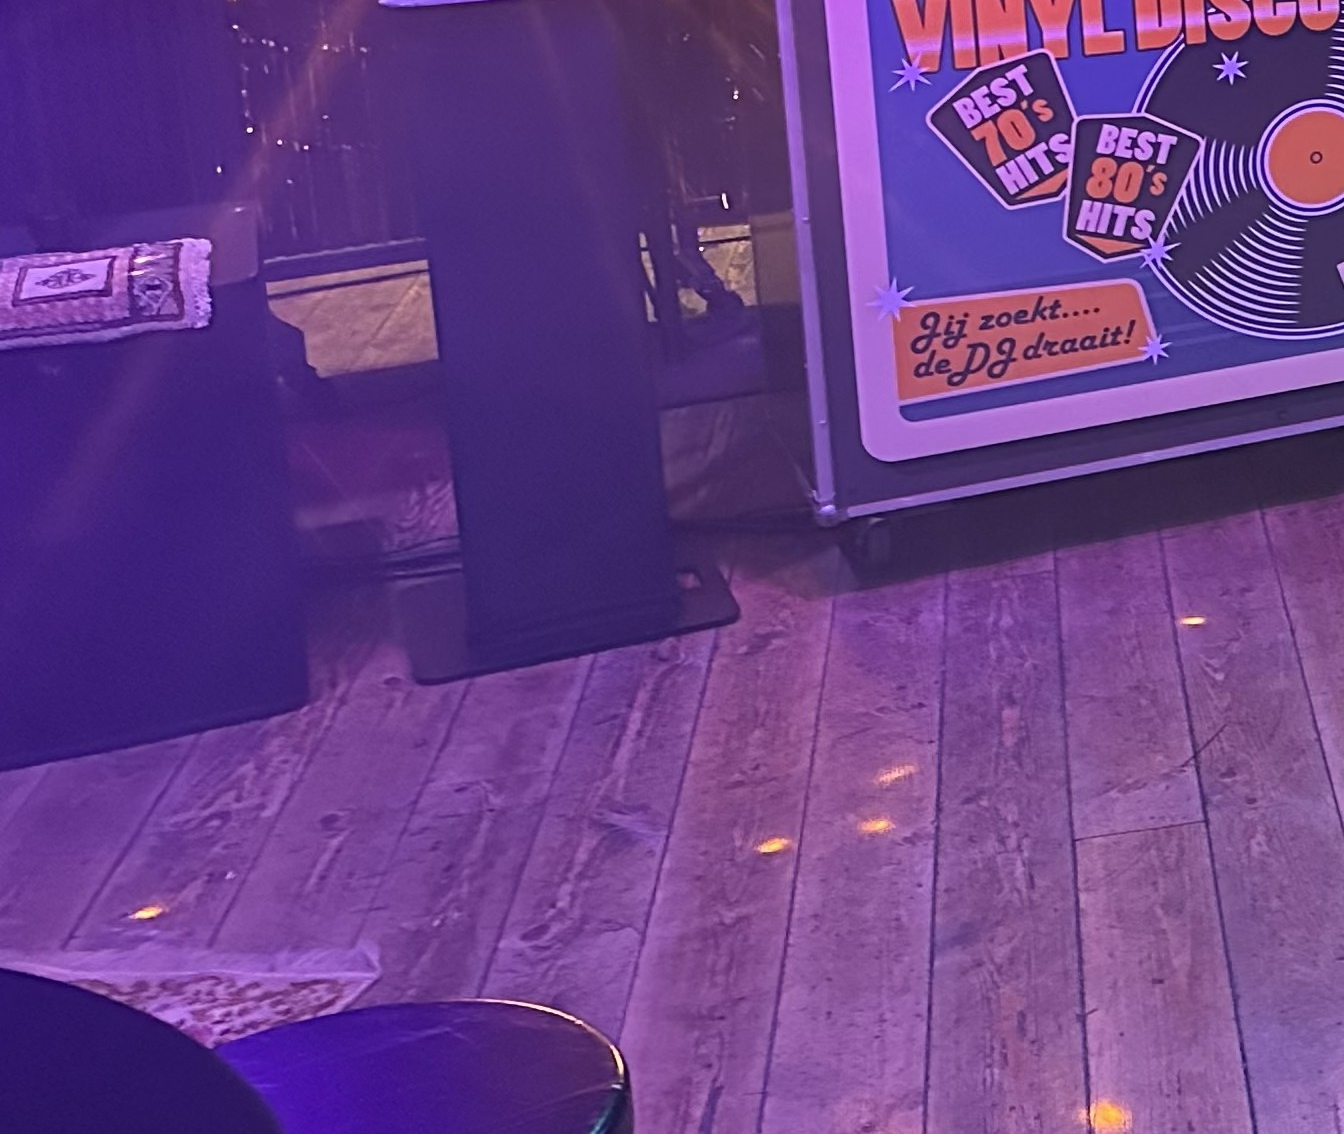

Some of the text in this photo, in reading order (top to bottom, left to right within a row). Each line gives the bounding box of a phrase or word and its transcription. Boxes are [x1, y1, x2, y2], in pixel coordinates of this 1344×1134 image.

[952, 64, 1034, 129] BEST
[970, 98, 1054, 166] 70's
[1095, 123, 1178, 164] BEST
[995, 133, 1071, 195] HITS
[1085, 156, 1168, 203] 80's
[1075, 199, 1155, 240] HITS
[910, 311, 970, 355] Jij
[913, 319, 1137, 386] de DJ draait!
